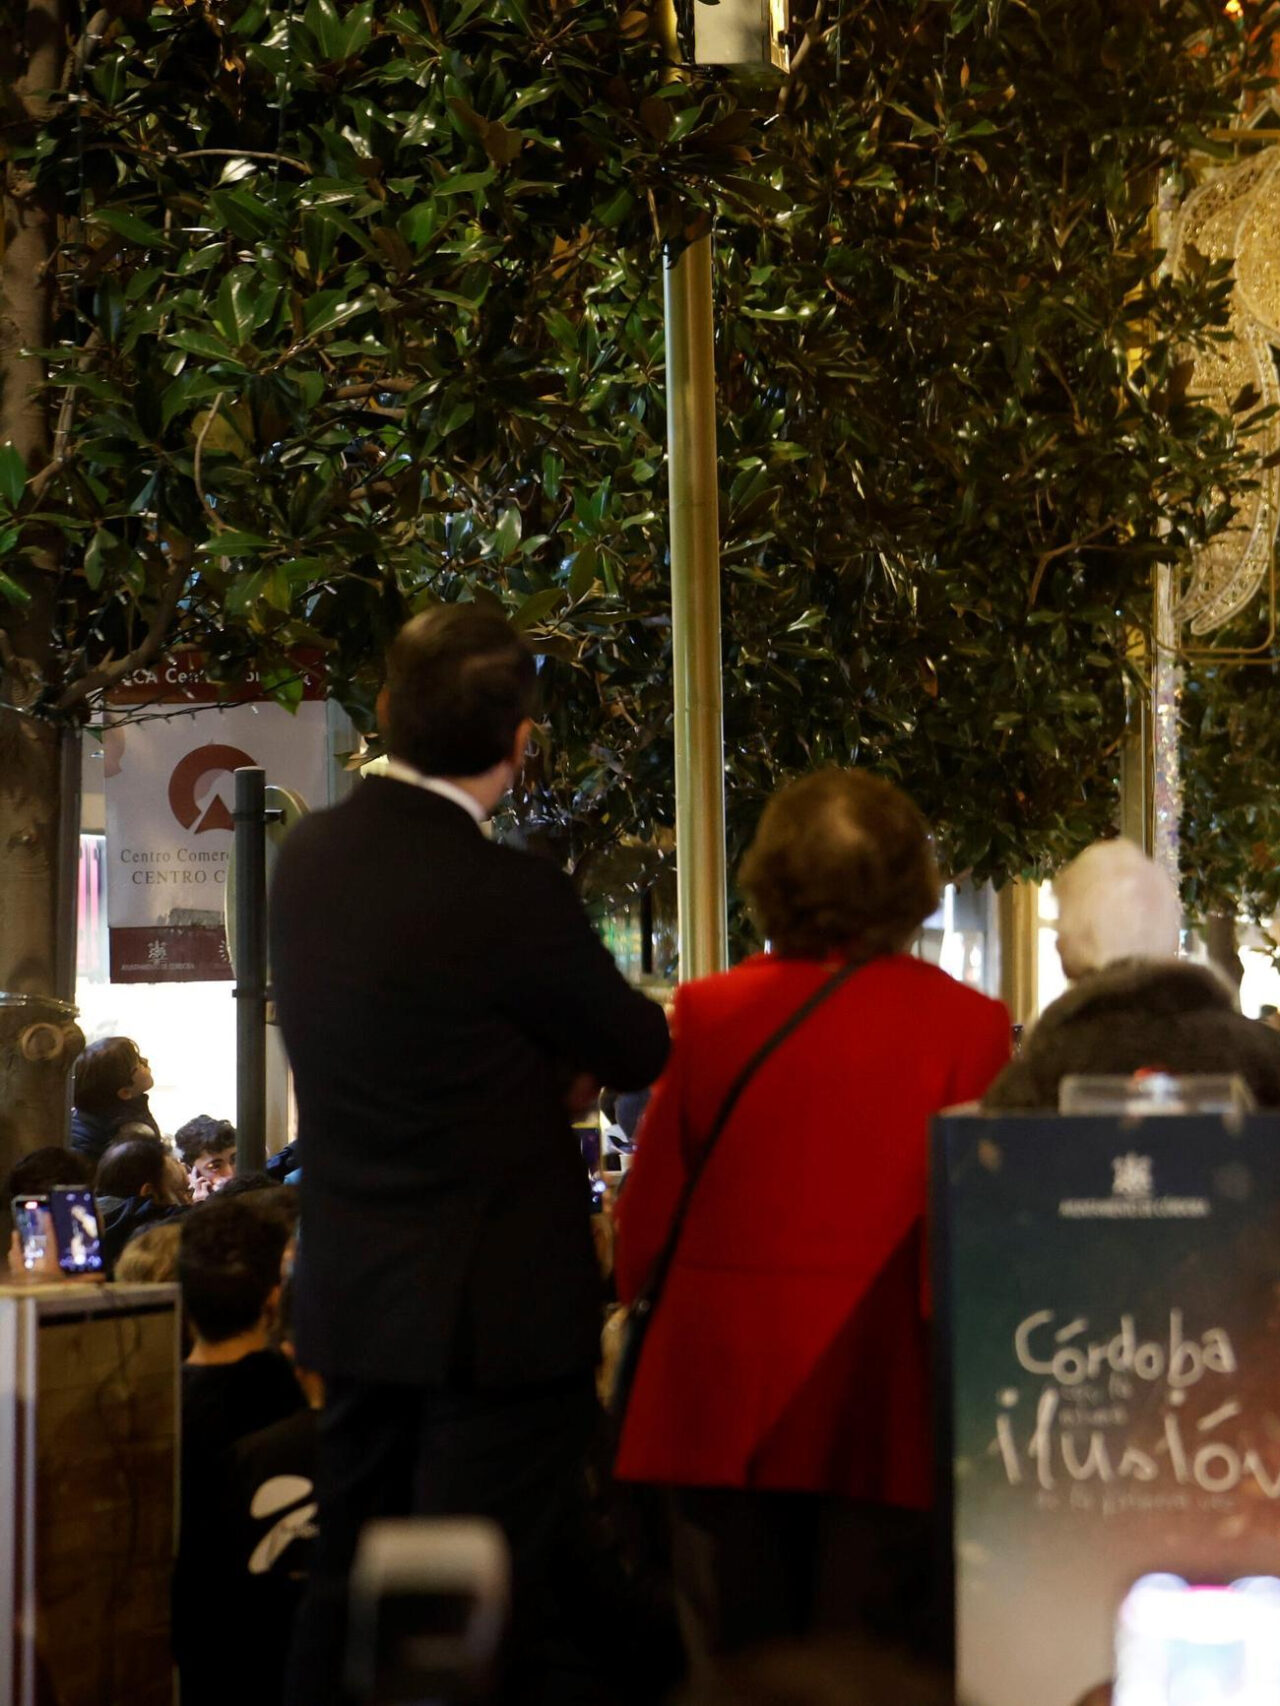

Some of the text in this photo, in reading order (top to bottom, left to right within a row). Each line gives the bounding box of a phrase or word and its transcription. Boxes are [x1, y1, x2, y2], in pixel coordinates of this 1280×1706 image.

[120, 848, 171, 864] Centro
[132, 869, 226, 885] CENTRO C
[1015, 1306, 1238, 1387] Córdoba
